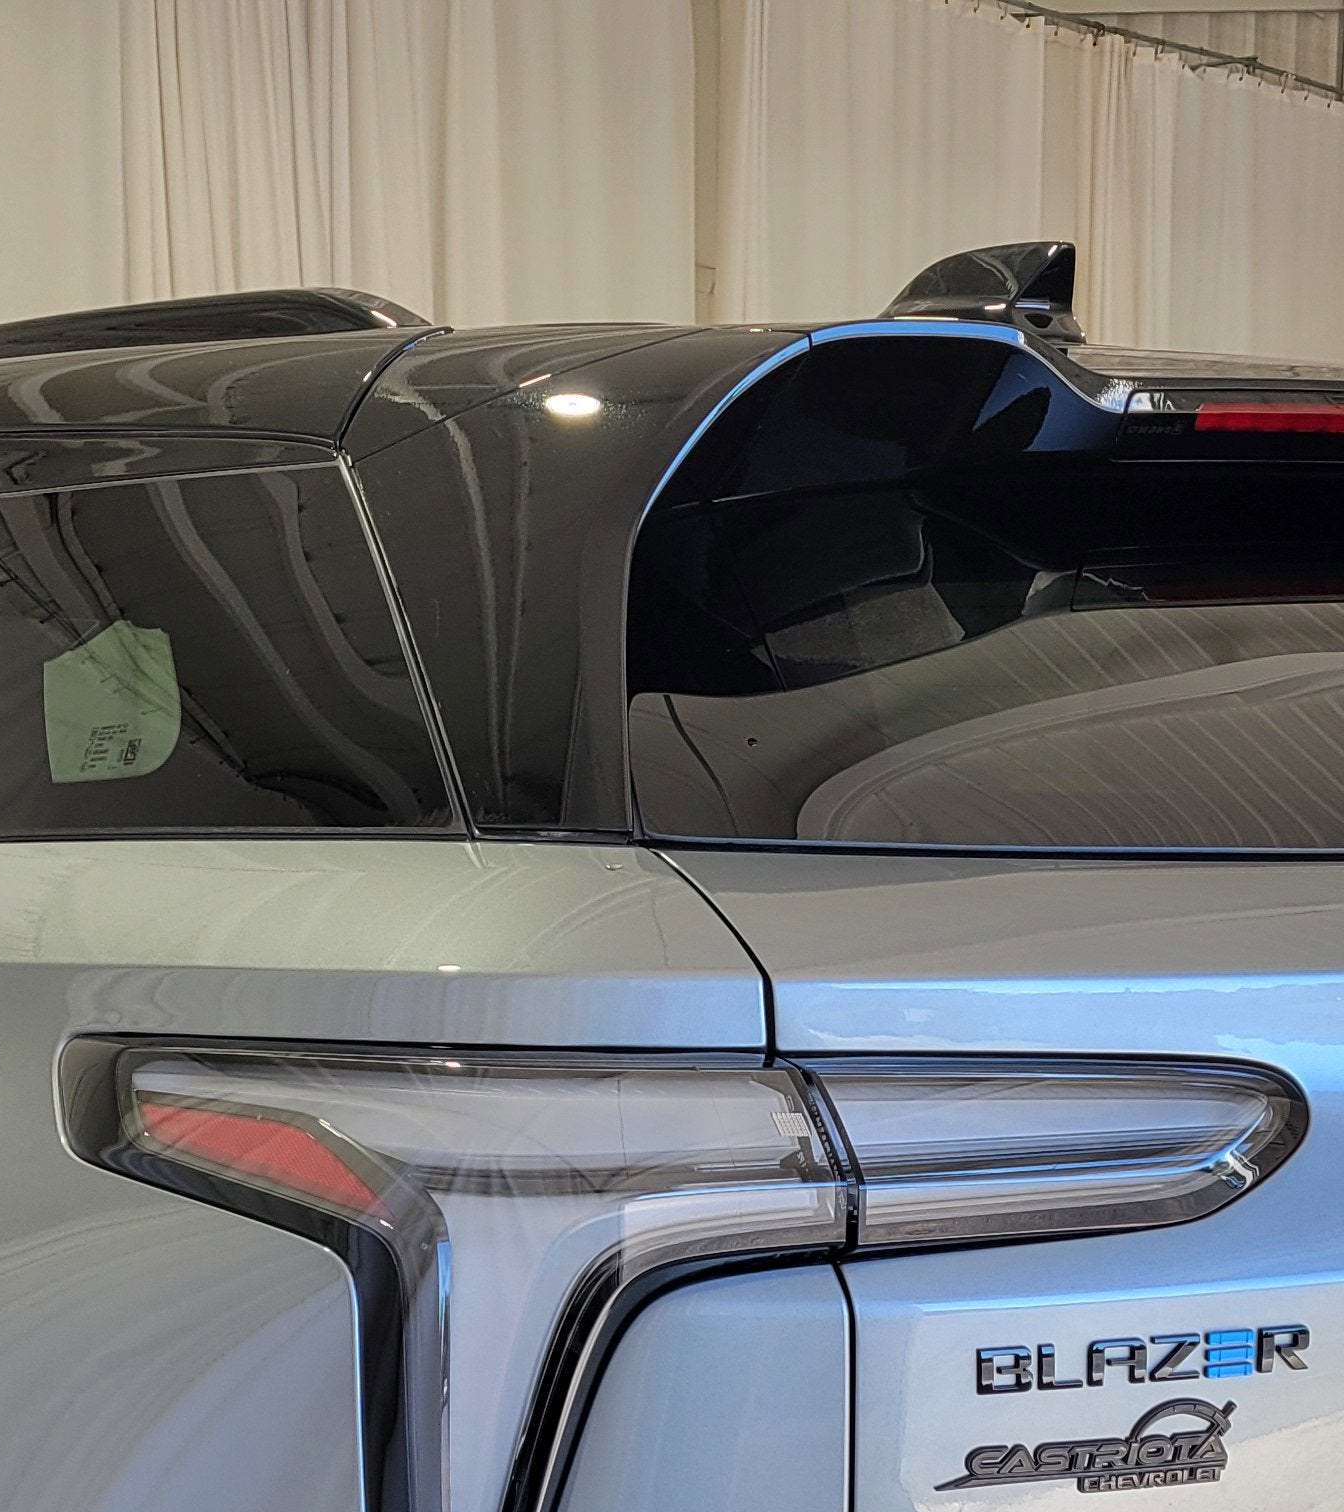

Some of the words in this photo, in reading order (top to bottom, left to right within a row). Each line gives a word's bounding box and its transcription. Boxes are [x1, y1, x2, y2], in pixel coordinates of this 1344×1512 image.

[975, 1324, 1310, 1396] BLAZER
[965, 1431, 1228, 1476] CASTRIOTA
[1080, 1464, 1223, 1492] CHEVROLET
